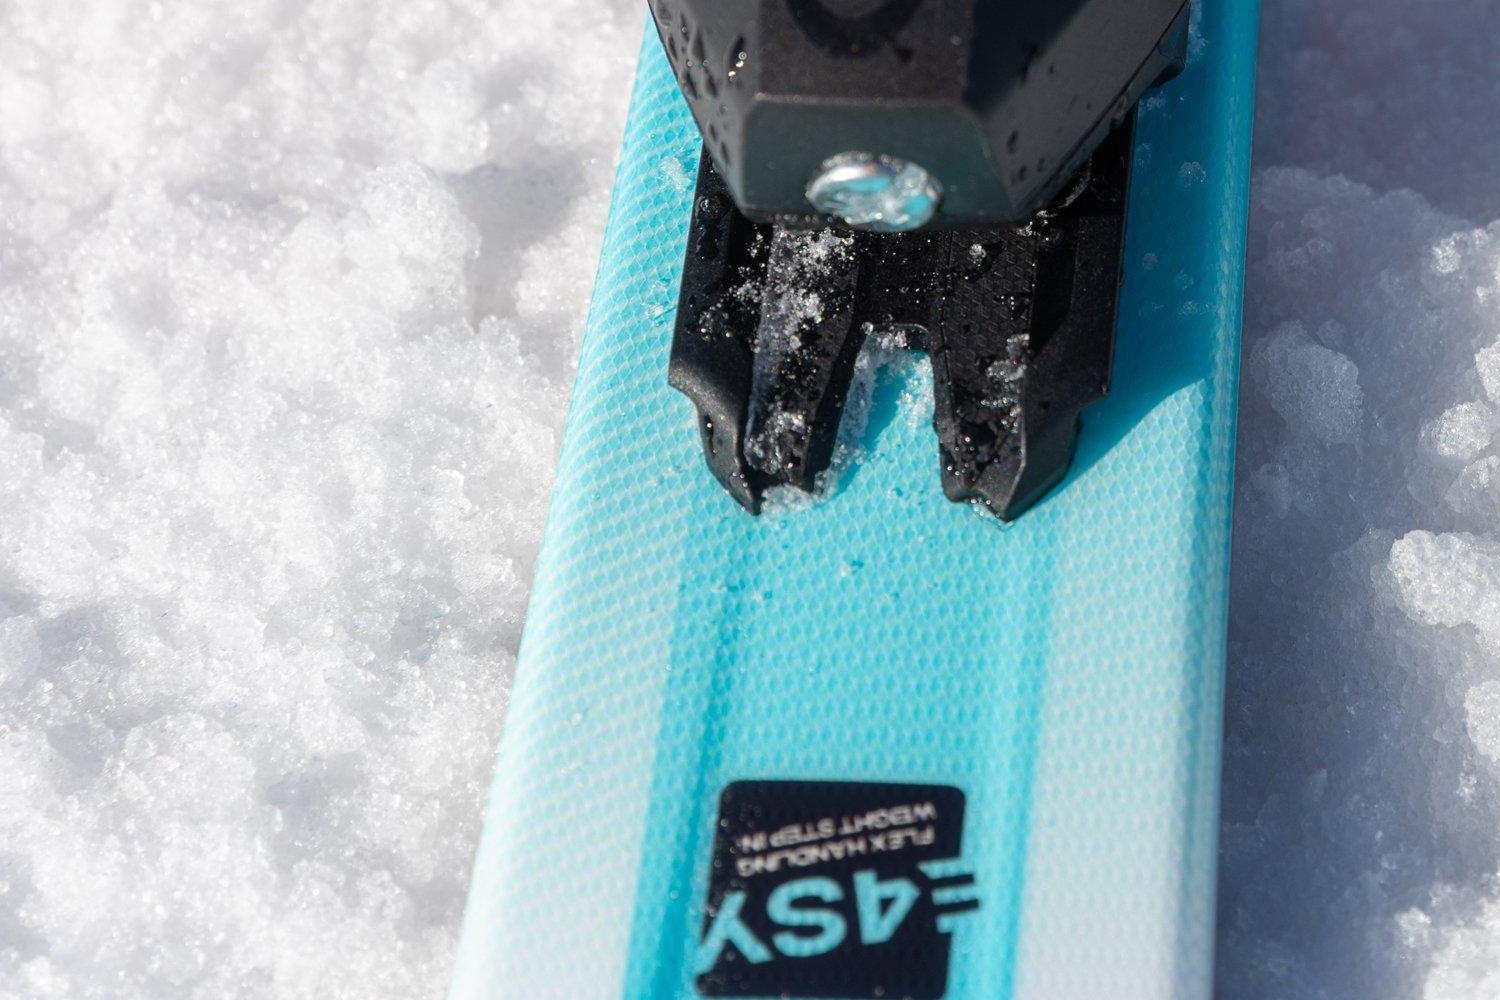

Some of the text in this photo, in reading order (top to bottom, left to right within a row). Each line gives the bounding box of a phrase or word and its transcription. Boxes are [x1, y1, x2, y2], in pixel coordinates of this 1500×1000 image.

[736, 824, 936, 878] FLEX HANDLING
[739, 801, 937, 855] WEIGHT STEP IN
